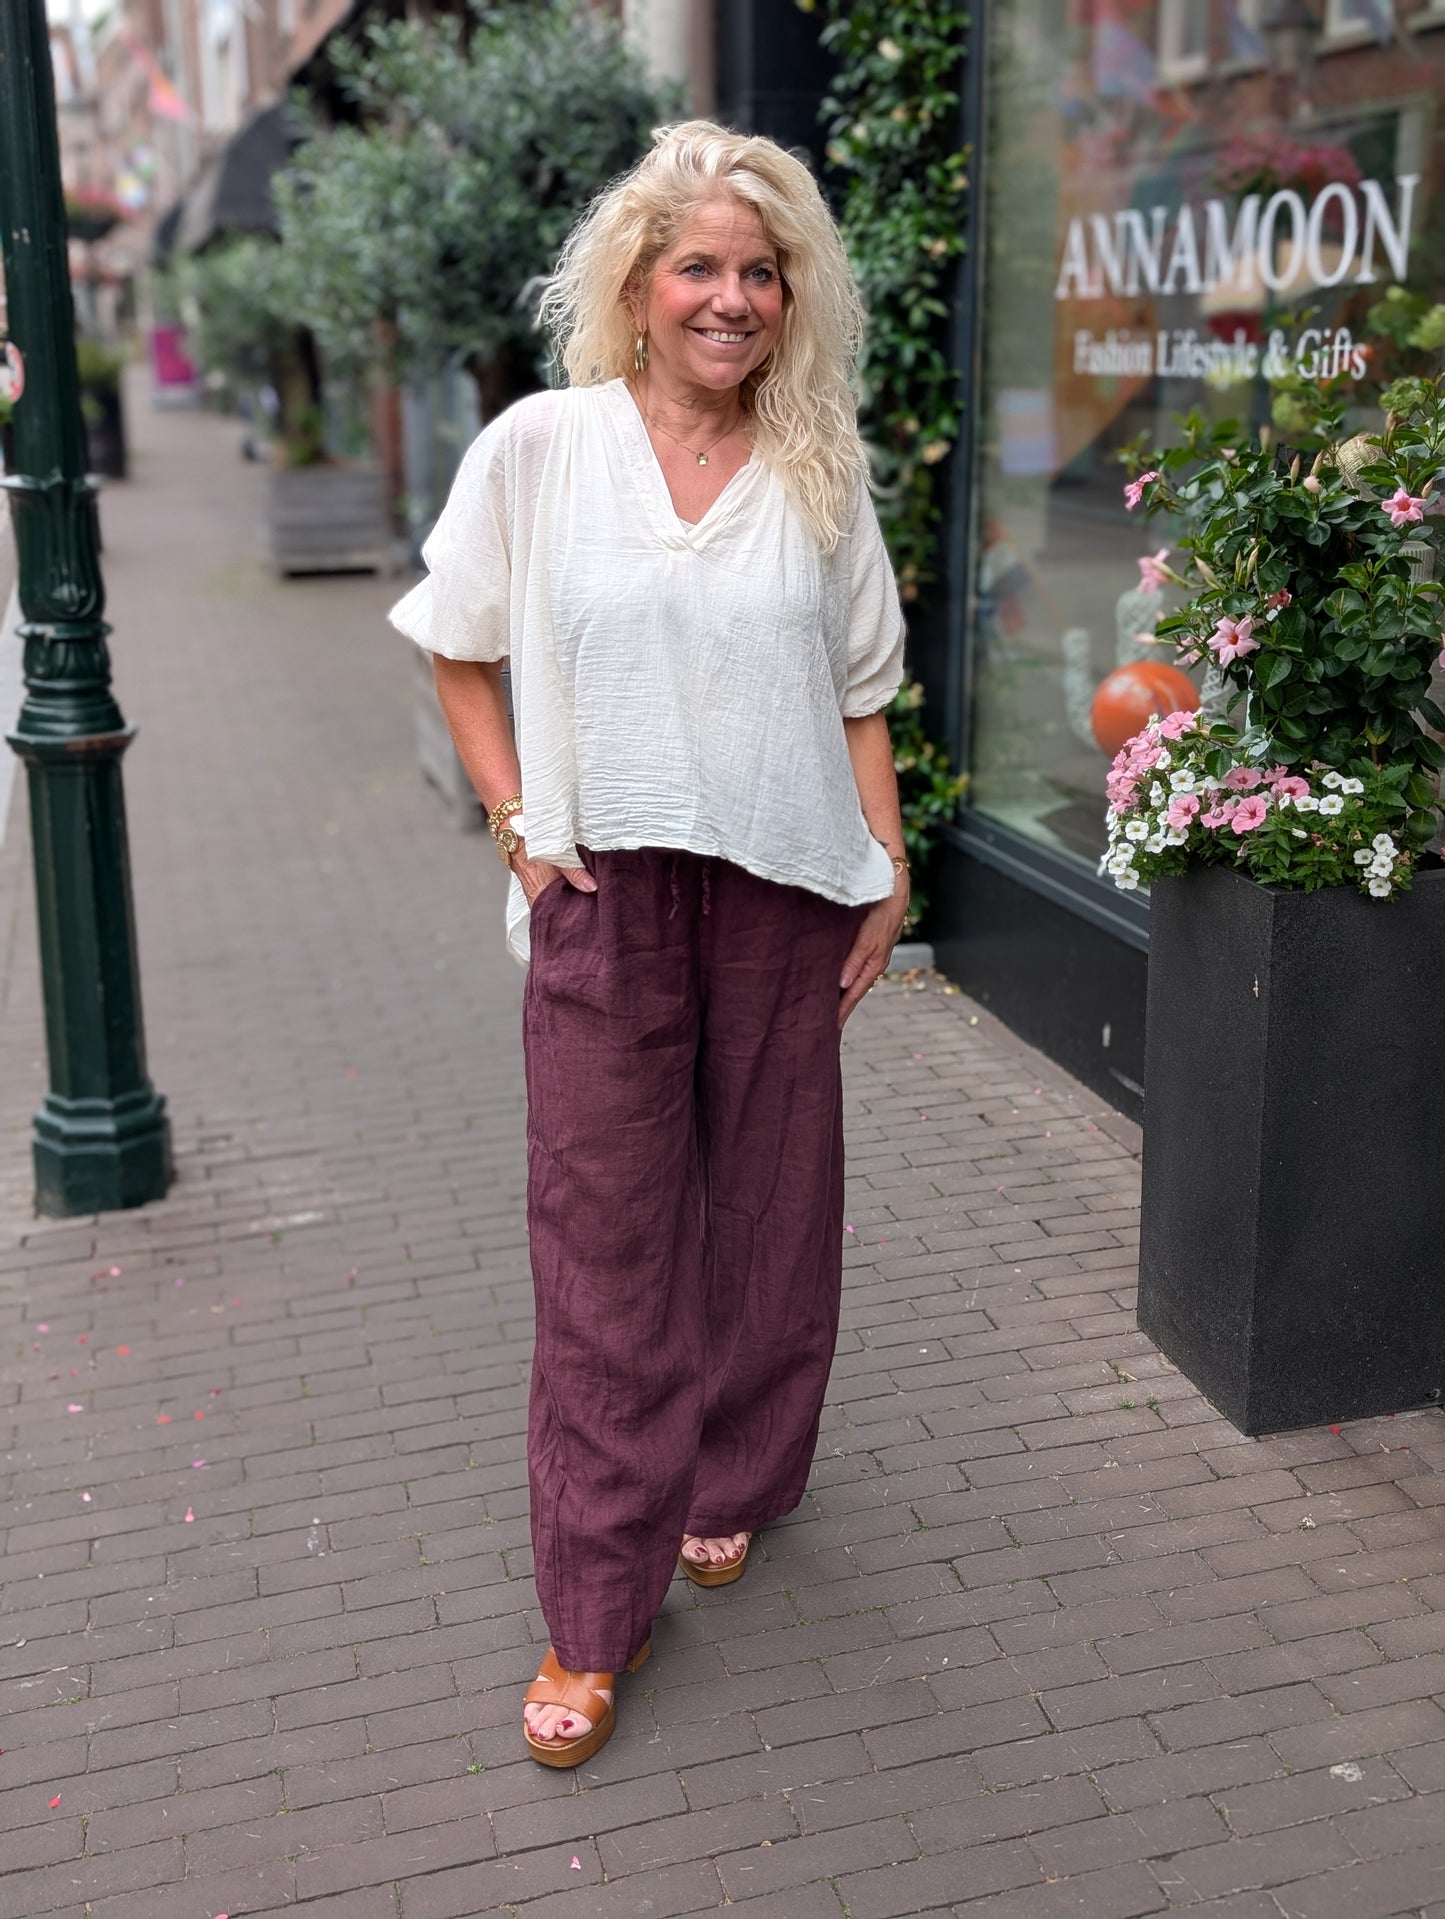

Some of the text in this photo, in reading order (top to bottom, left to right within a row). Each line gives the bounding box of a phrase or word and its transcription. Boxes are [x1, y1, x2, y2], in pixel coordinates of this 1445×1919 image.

[1055, 173, 1420, 299] ANNAMOON
[1073, 326, 1367, 390] Fashion Lifestyle & Gifts
